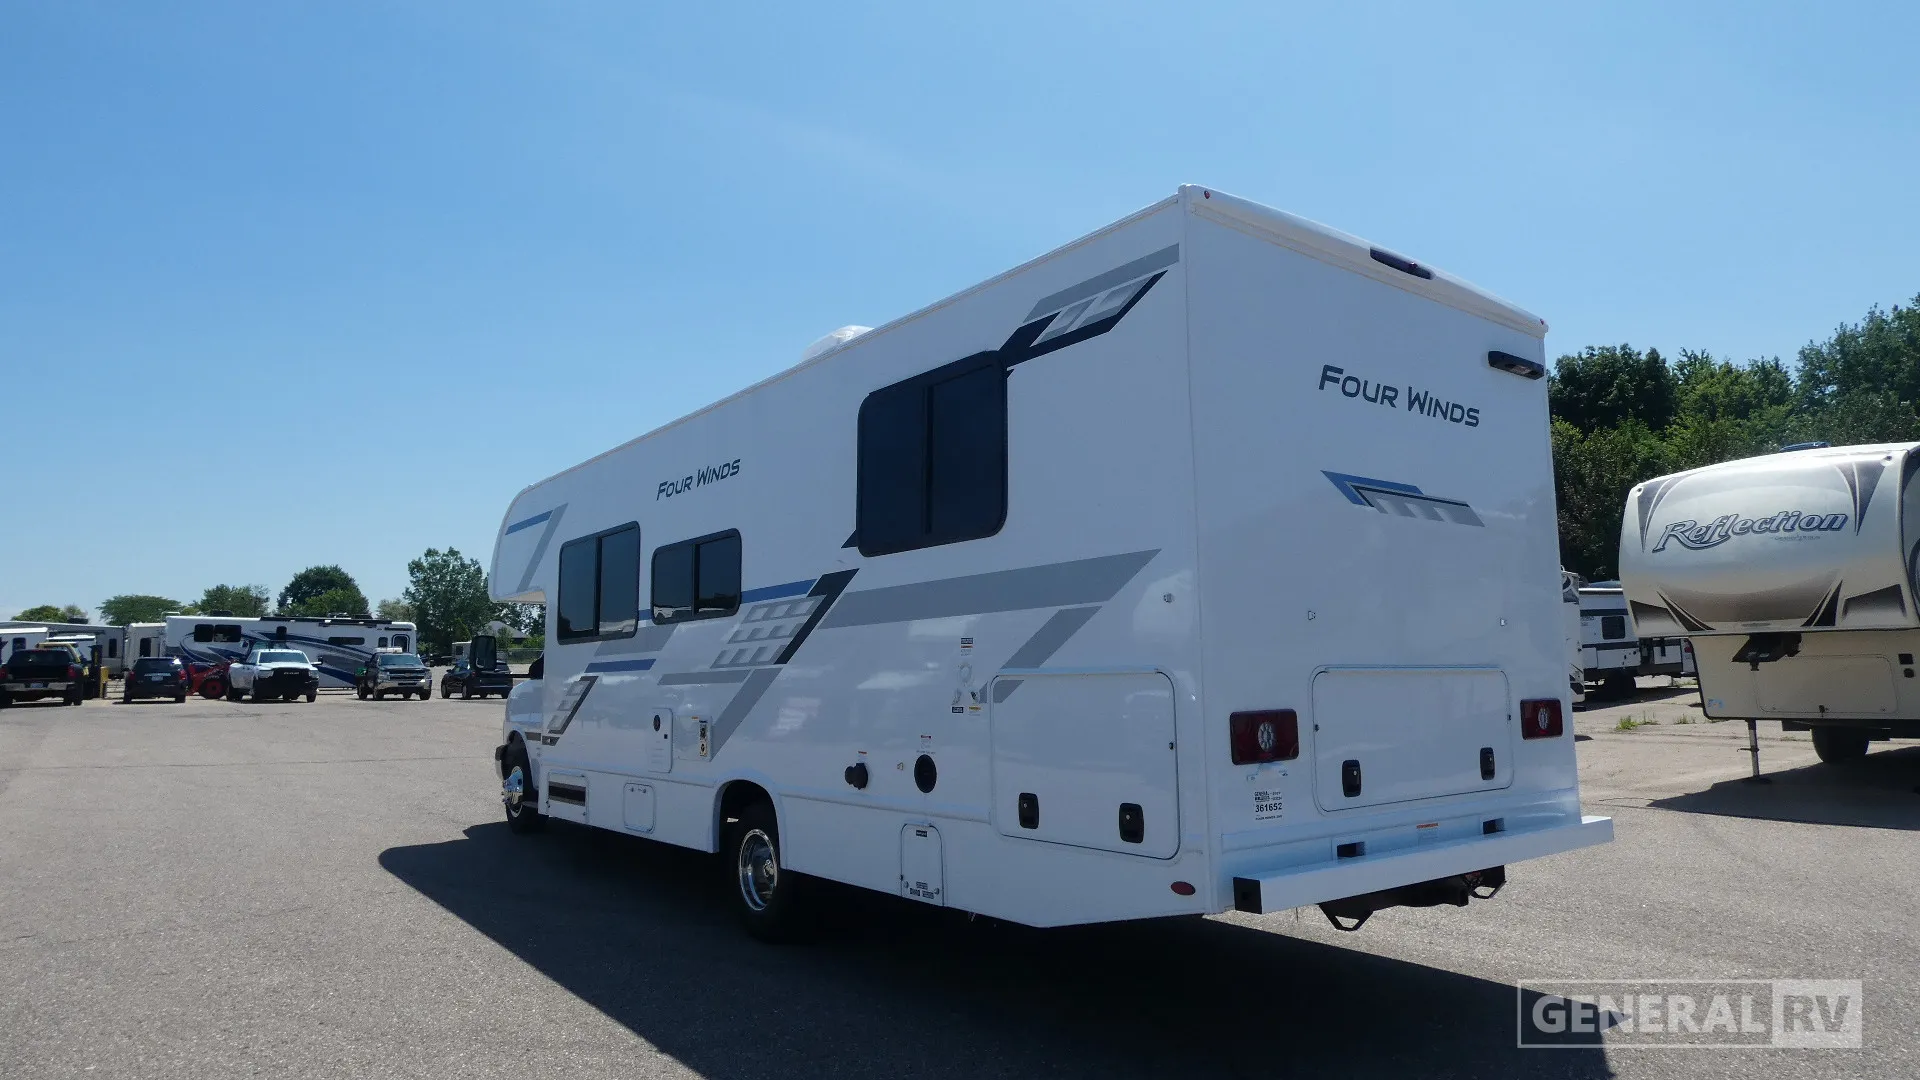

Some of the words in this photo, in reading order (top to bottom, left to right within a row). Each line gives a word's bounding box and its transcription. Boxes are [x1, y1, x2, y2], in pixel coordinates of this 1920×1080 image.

[1318, 364, 1399, 408] FOUR
[1407, 386, 1480, 428] WINDS
[656, 475, 693, 501] FOUR
[697, 458, 741, 488] WINDS
[1652, 510, 1849, 553] Reflection
[1255, 802, 1283, 813] 361652
